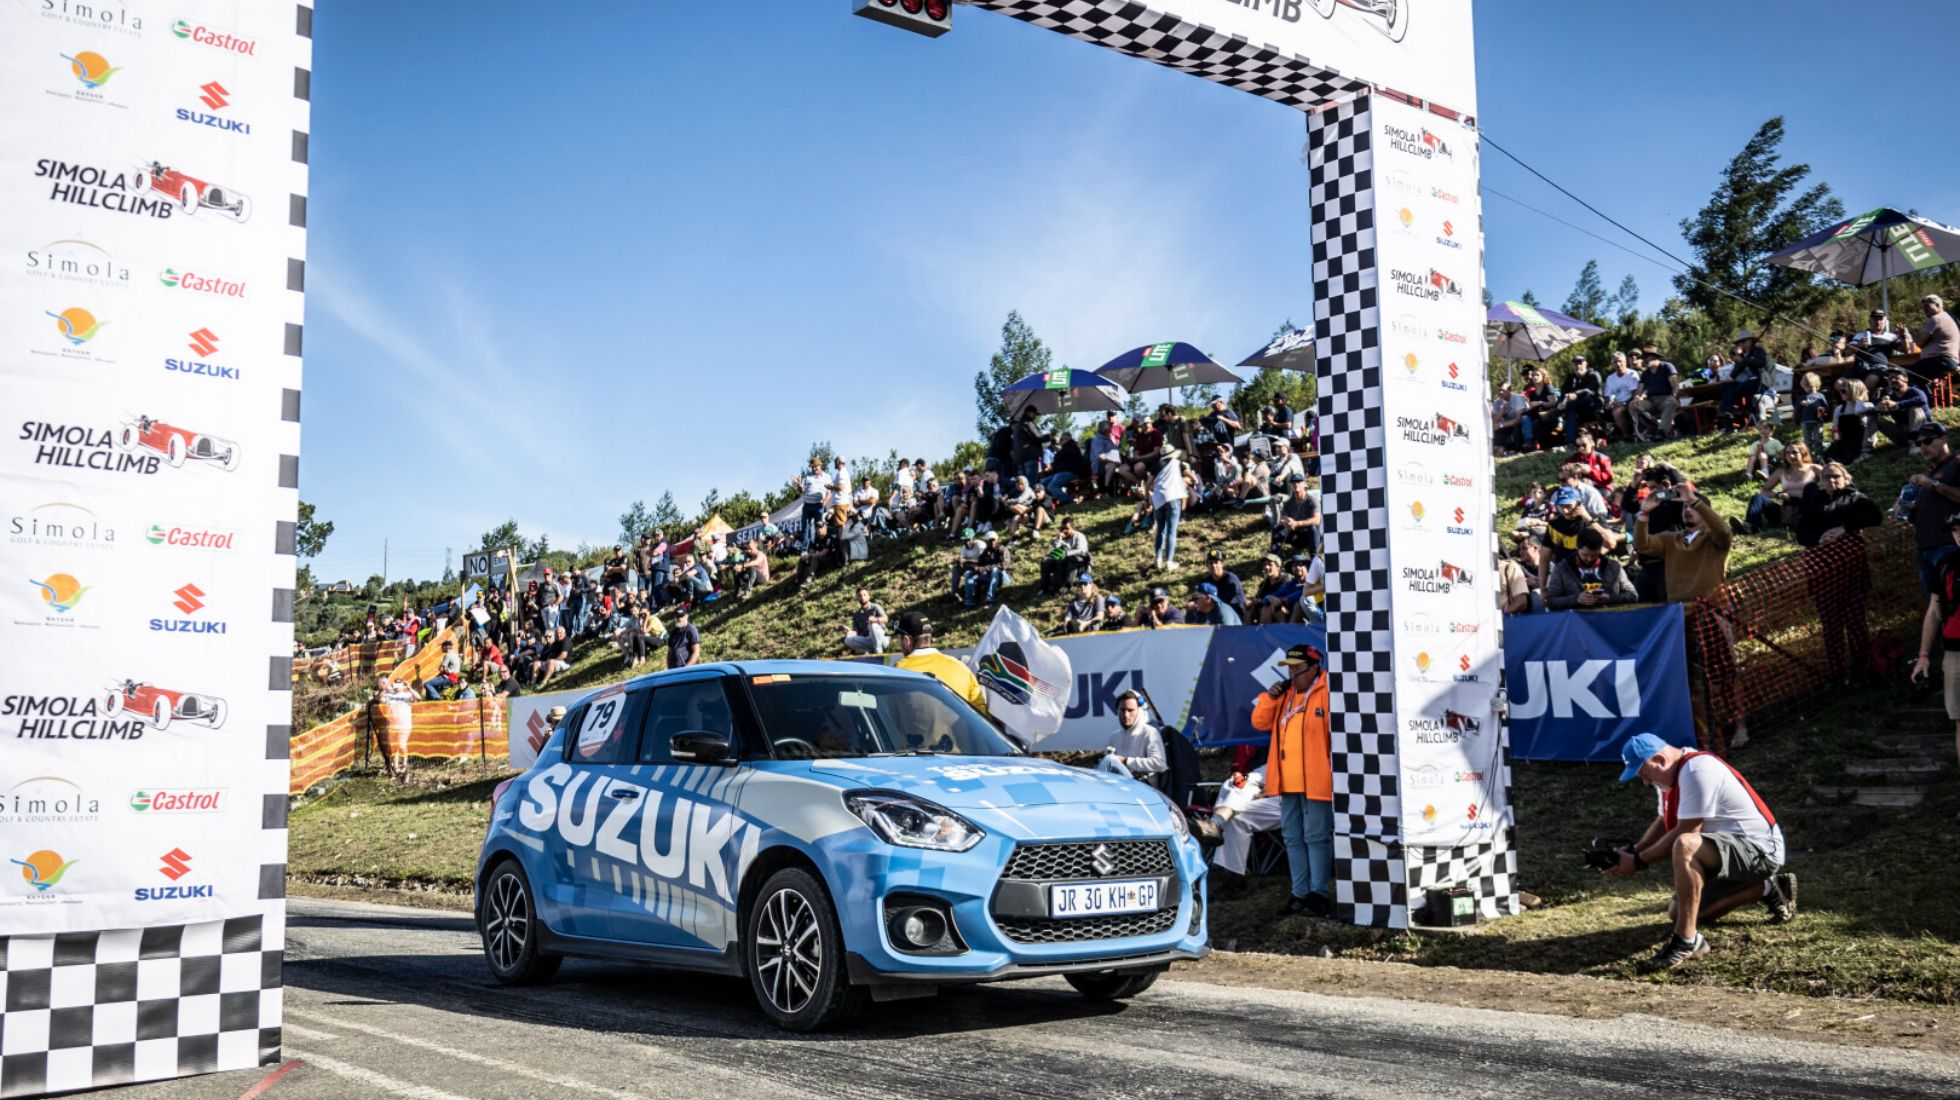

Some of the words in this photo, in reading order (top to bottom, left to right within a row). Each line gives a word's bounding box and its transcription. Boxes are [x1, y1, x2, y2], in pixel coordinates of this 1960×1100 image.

[41, 0, 143, 31] Simola
[193, 25, 256, 56] Castrol
[176, 108, 250, 135] SUZUKI
[1384, 125, 1415, 142] SIMOLA
[1390, 139, 1432, 159] HILLCLIMB
[35, 159, 126, 191] SIMOLA
[50, 182, 173, 219] HILLCLIMB
[26, 251, 130, 281] Simola
[1390, 269, 1423, 284] SIMOLA
[181, 273, 246, 298] Castrol
[1397, 282, 1440, 301] HILLCLIMB
[165, 359, 240, 380] SUZUKI
[1397, 417, 1429, 431] SIMOLA
[19, 421, 113, 449] SIMOLA
[1403, 430, 1446, 446] HILLCLIMB
[35, 445, 160, 475] HILLCLIMB
[10, 516, 115, 542] Simola
[167, 527, 233, 549] Castrol
[737, 529, 758, 544] SEAT
[1447, 526, 1473, 536] SUZUKI
[470, 556, 487, 575] NO
[1403, 568, 1434, 580] SIMOLA
[1409, 580, 1450, 594] HILLCLIMB
[149, 619, 227, 634] SUZUKI
[1, 696, 97, 717] SIMOLA
[588, 700, 616, 731] 79
[16, 719, 144, 740] HILLCLIMB
[1408, 720, 1440, 731] SIMOLA
[1416, 733, 1459, 744] HILLCLIMB
[152, 791, 219, 810] Castrol
[519, 763, 761, 904] SUZUKI
[134, 885, 213, 901] SUZUKI
[1058, 889, 1076, 912] JR
[1085, 888, 1101, 910] 30
[1109, 886, 1126, 909] KH
[1139, 885, 1153, 906] GP
